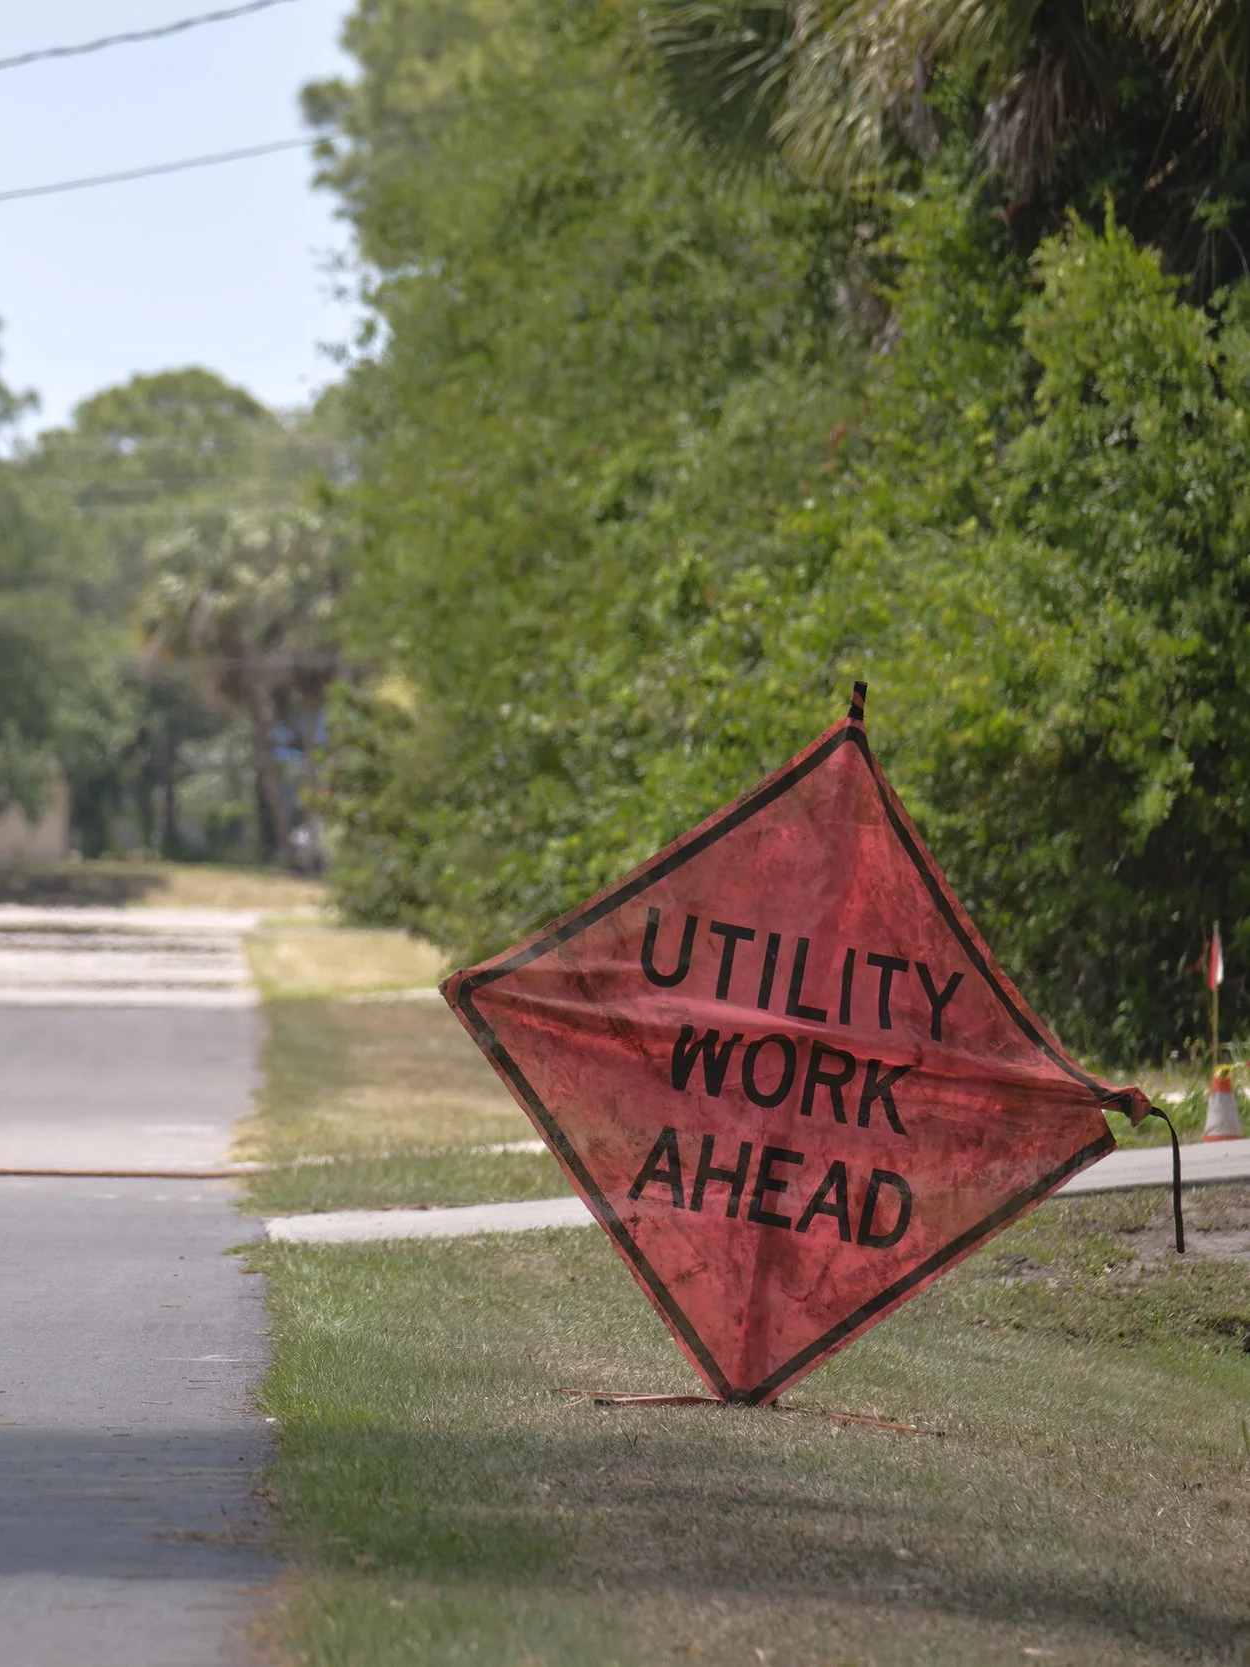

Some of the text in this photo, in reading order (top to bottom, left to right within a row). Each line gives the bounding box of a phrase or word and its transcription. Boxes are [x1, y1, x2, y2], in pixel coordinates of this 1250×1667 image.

[641, 907, 964, 1042] UTILITY
[671, 1024, 913, 1136] WORK
[627, 1126, 913, 1249] AHEAD
